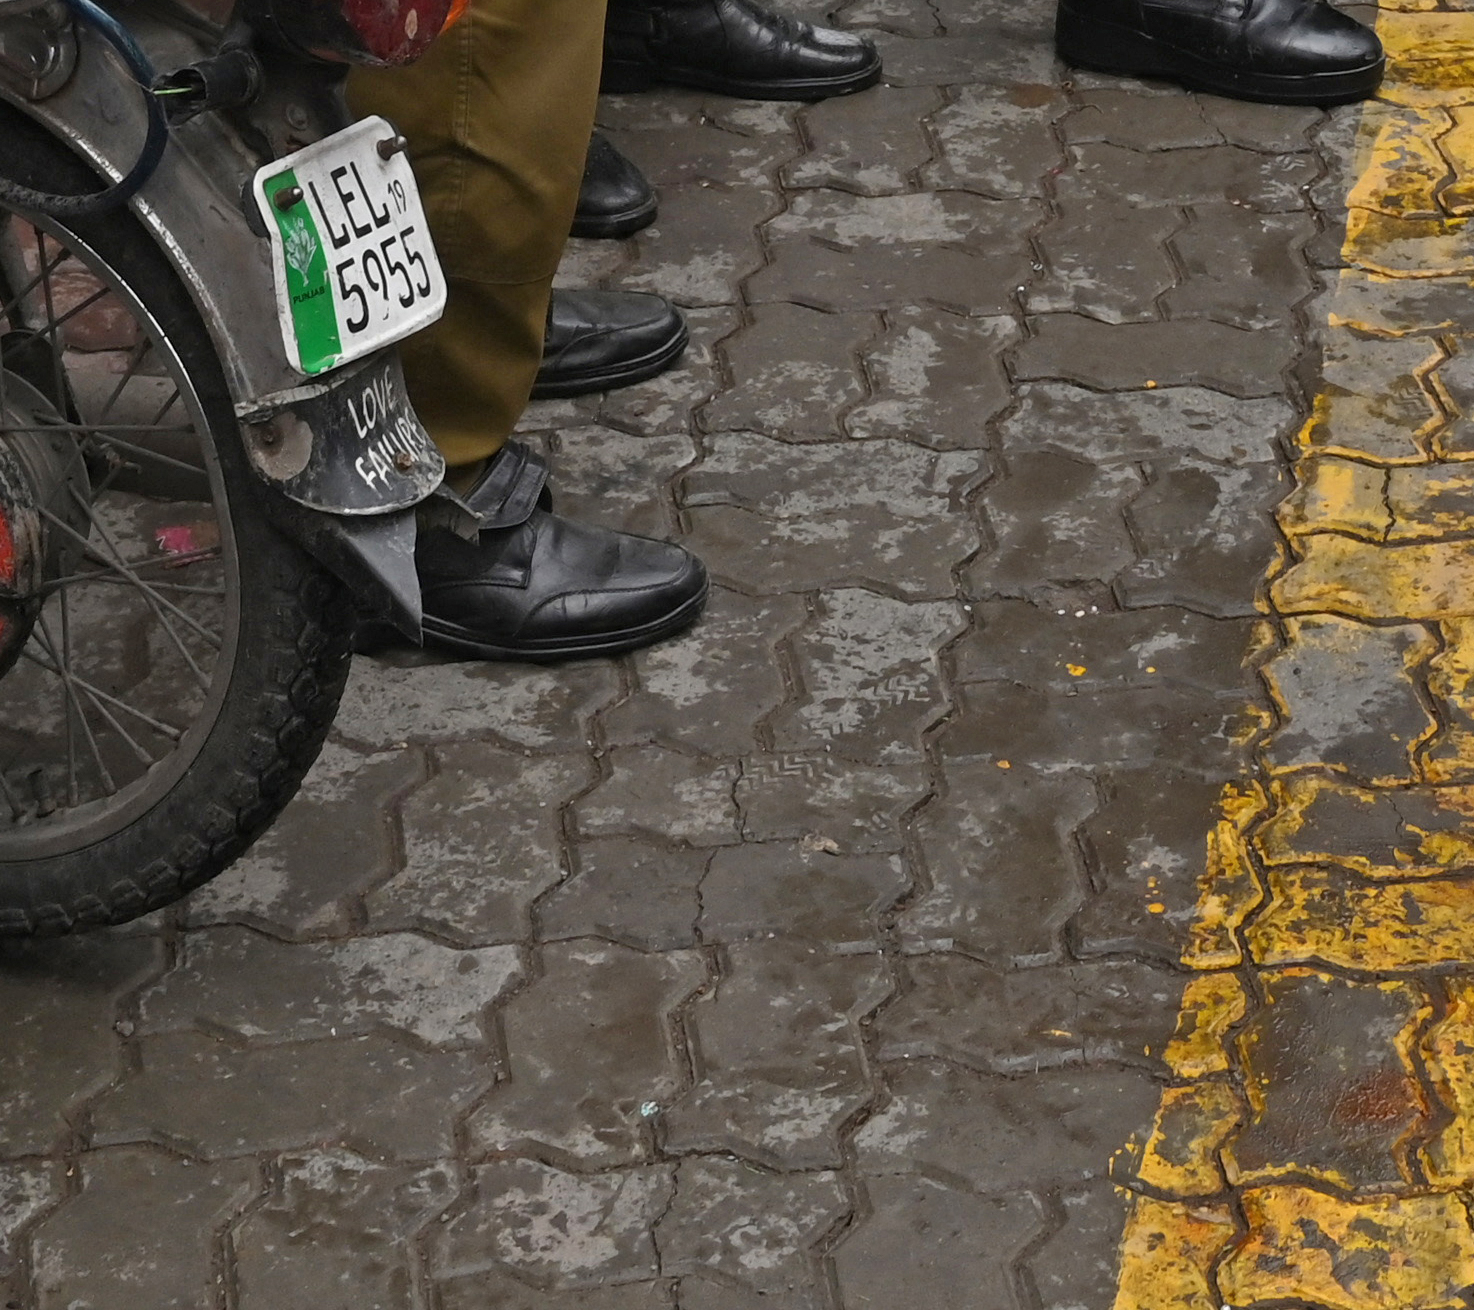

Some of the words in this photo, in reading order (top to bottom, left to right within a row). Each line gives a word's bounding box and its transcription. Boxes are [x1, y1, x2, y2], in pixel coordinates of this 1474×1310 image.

[308, 161, 391, 250] LEL
[387, 179, 407, 215] 19
[293, 285, 325, 305] PUNJAB
[336, 225, 432, 334] 5955
[347, 364, 398, 440] LOVE
